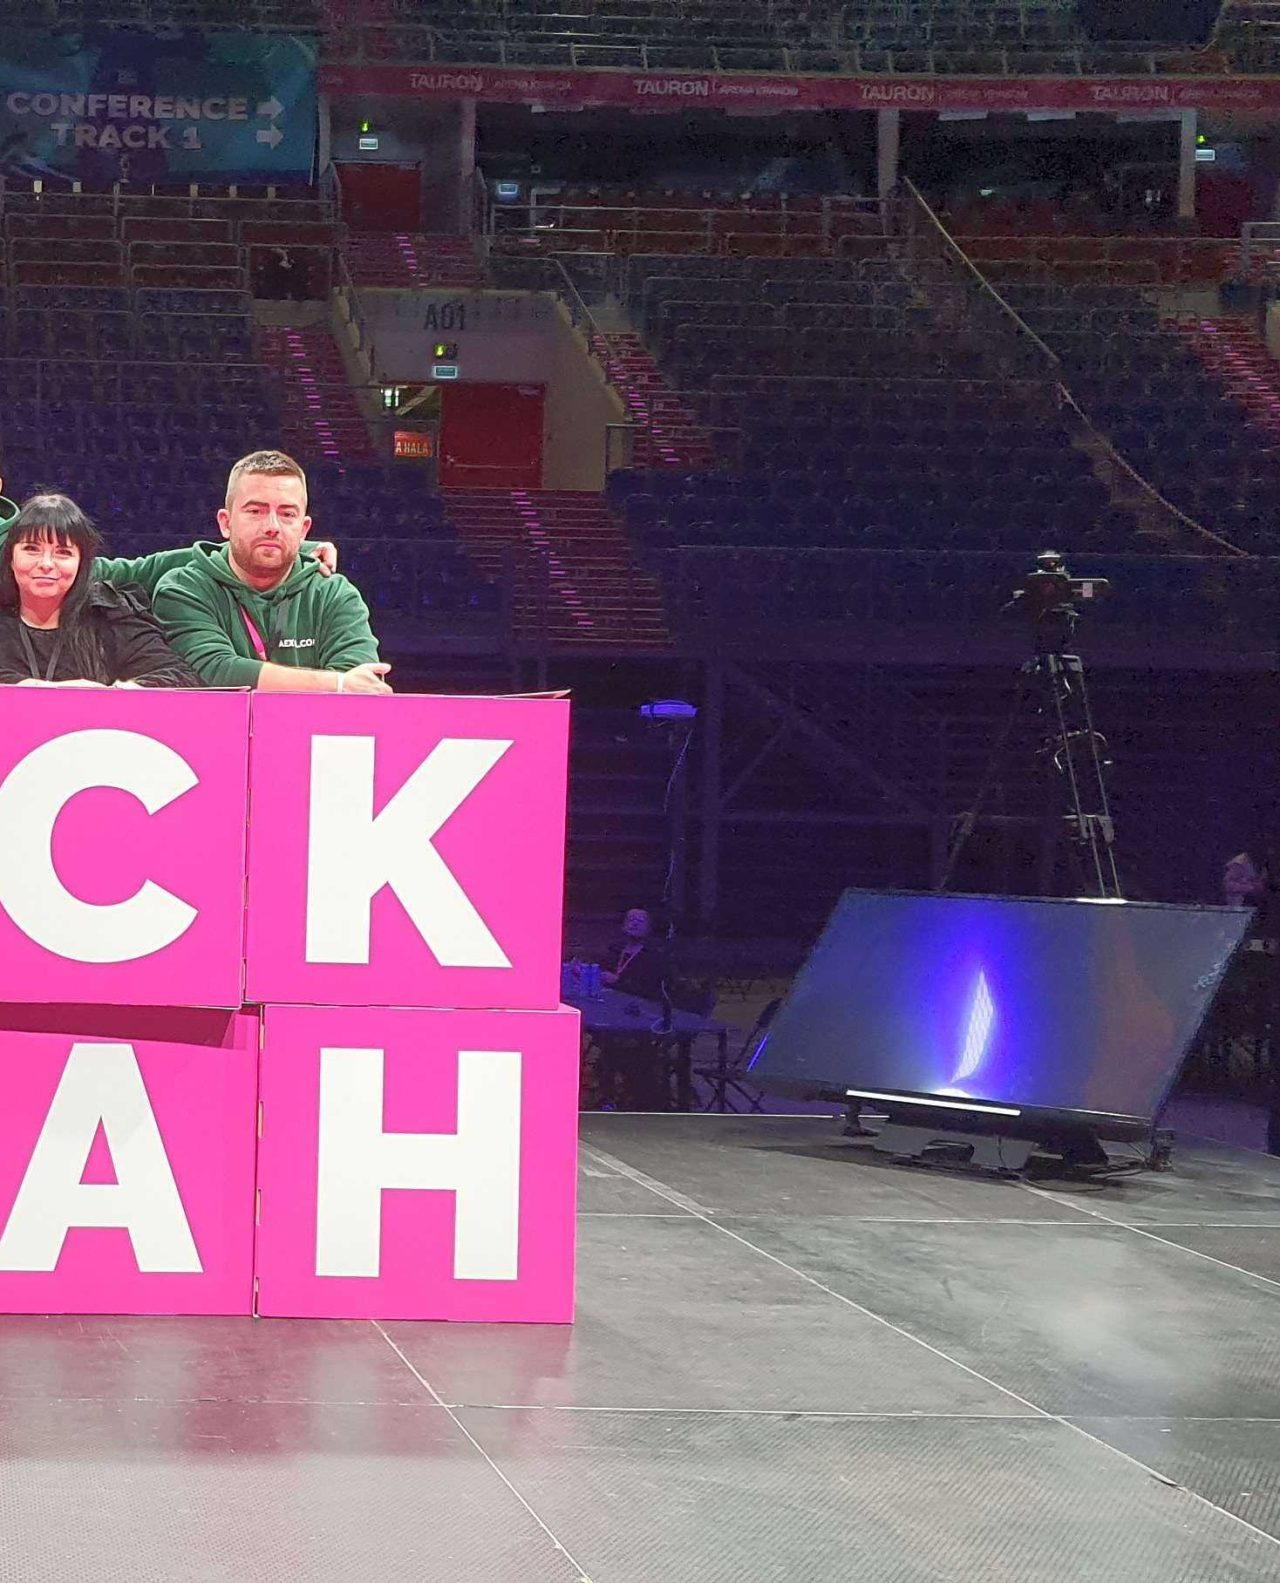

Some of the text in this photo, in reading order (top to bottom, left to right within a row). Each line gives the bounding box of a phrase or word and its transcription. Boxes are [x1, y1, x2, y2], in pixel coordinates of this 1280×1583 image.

[409, 74, 483, 91] TAURON
[634, 80, 708, 96] TAURON
[860, 84, 934, 102] TAURON
[1094, 86, 1169, 101] TAURON
[6, 91, 249, 121] CONFERENCE
[51, 123, 202, 150] TRACK 1
[424, 302, 466, 330] A01
